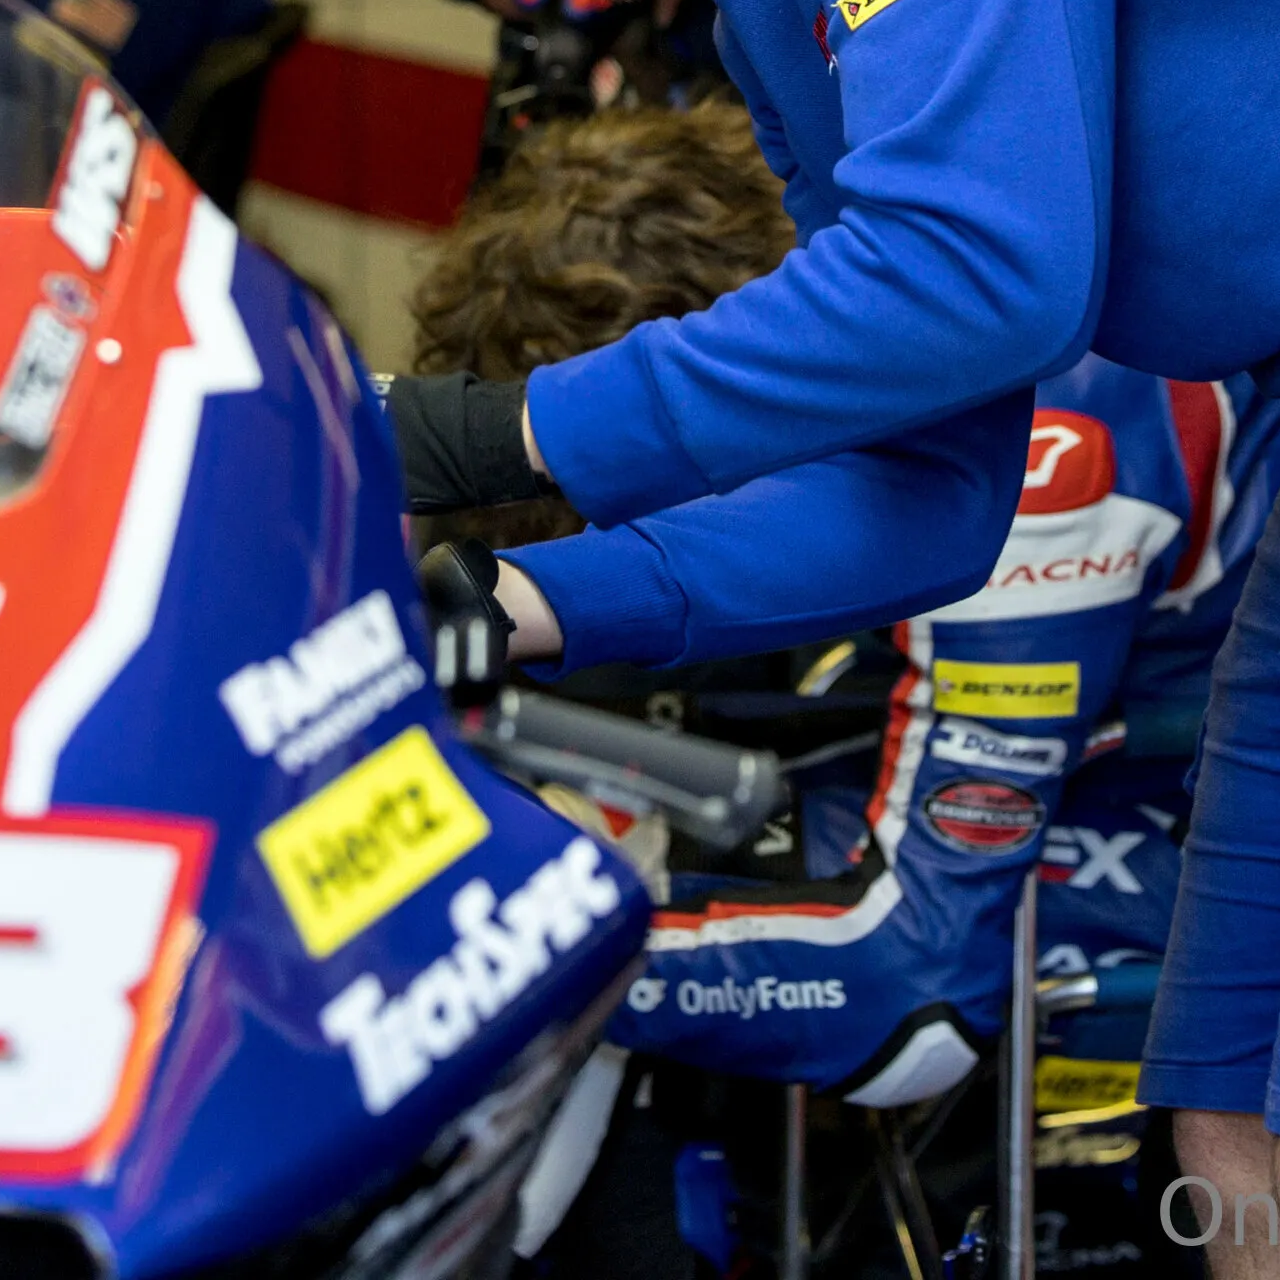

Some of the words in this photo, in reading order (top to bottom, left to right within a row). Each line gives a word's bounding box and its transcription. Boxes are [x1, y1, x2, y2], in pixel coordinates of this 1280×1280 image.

[986, 548, 1141, 588] ACNA
[961, 680, 1073, 698] DUNLOP
[293, 775, 450, 904] Hertz
[676, 976, 847, 1020] OnlyFans
